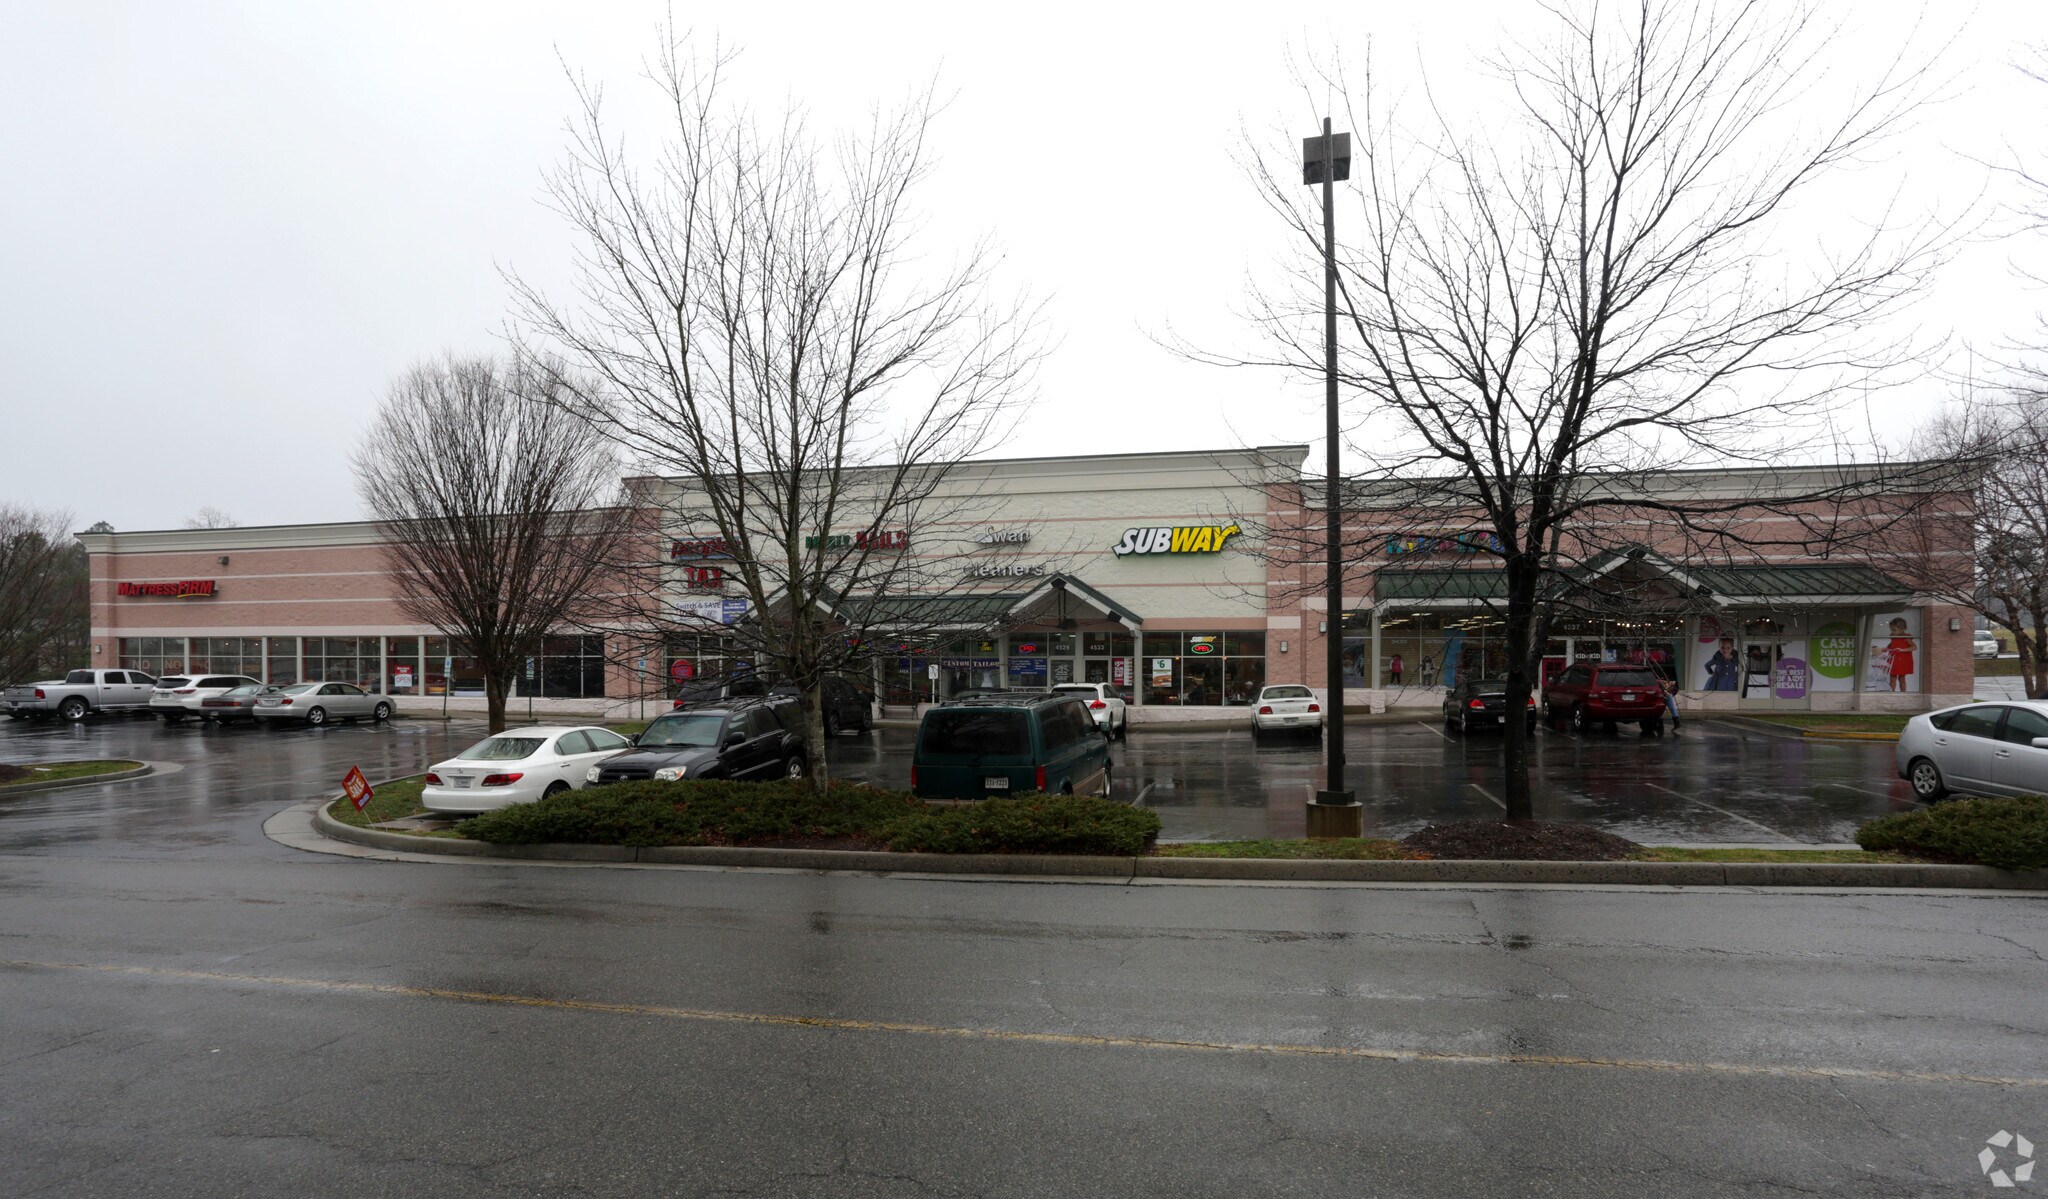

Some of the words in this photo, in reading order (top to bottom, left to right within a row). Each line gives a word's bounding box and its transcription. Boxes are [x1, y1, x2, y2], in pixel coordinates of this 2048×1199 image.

[856, 530, 907, 550] NAILS
[1113, 524, 1240, 557] SUBWAY
[683, 567, 724, 588] TAX
[1821, 638, 1854, 649] CASH
[165, 660, 182, 669] NO
[1821, 657, 1855, 667] STUFF
[350, 777, 365, 798] SALE
